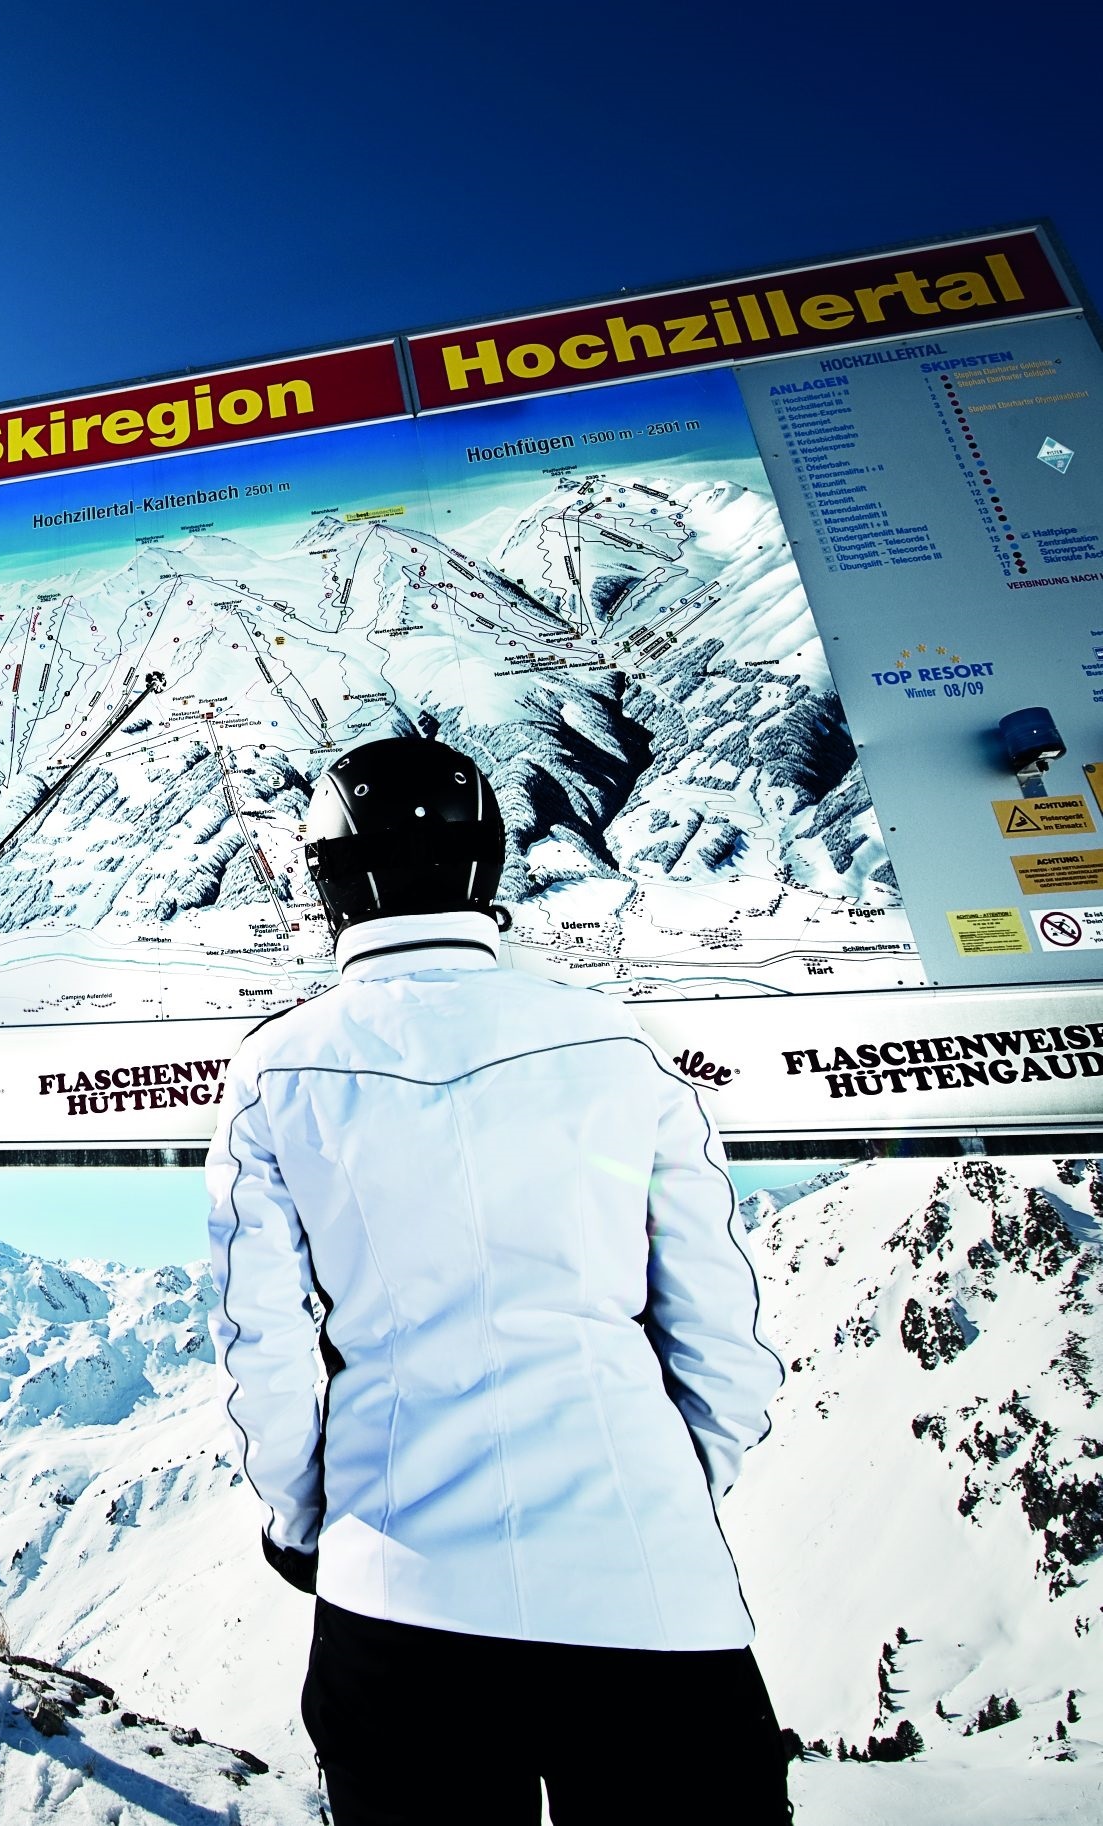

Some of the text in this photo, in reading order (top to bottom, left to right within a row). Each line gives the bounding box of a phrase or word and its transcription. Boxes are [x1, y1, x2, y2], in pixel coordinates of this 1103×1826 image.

[442, 253, 1025, 391] Hochzillertal
[820, 343, 948, 373] HOCHZILLERTAL
[920, 351, 1014, 374] SKIPISTEN
[953, 369, 982, 379] Stephan
[769, 375, 850, 396] ANLAGEN
[958, 378, 985, 388] Stephan
[782, 392, 831, 405] Hochzillertal
[785, 400, 834, 413] Hochzillertal
[968, 404, 996, 414] Stephan
[788, 407, 852, 421] Schnee-Express
[791, 418, 832, 429] Sonnenjet
[466, 420, 700, 463] Hochfügen 1500 m 2501 m
[800, 442, 855, 455] Wedelexpress
[803, 455, 828, 464] Topjet
[809, 467, 865, 480] Panoramalifte
[245, 483, 274, 497] 2501
[278, 481, 290, 492] m
[812, 479, 846, 489] Mizunlift
[815, 485, 867, 498] Neuhüttenlift
[818, 496, 854, 507] Zirbenlift
[821, 503, 877, 516] Marendalmlift
[824, 512, 880, 525] Marendalmlift
[982, 516, 992, 524] 13
[827, 522, 869, 534] Übungslift
[830, 525, 928, 543] Kindergartenlift Marend
[1032, 527, 1078, 538] Halfpipe
[833, 541, 876, 553] Übungslift
[883, 535, 925, 546] Telecorde
[1037, 534, 1099, 547] Zentralstation
[836, 550, 879, 562] Übungslift
[887, 544, 928, 555] Telecorde
[997, 544, 1095, 561] 16 Snowpark
[840, 560, 883, 571] Übungslift
[890, 554, 932, 565] Telecorde
[1000, 561, 1011, 569] 17
[1043, 554, 1082, 564] Skiroute
[1007, 573, 1099, 589] VERBINDUNG NACH
[871, 662, 994, 686] TOP RESORT
[904, 681, 984, 699] Winter 08/09
[1034, 801, 1079, 810] ACHTUNG
[1040, 813, 1084, 822] Pistengerät
[1037, 857, 1080, 865] ACHTUNG
[848, 906, 885, 920] Fügen
[561, 920, 600, 930] Uderns
[807, 964, 834, 976] Hart
[238, 988, 273, 997] Stumm
